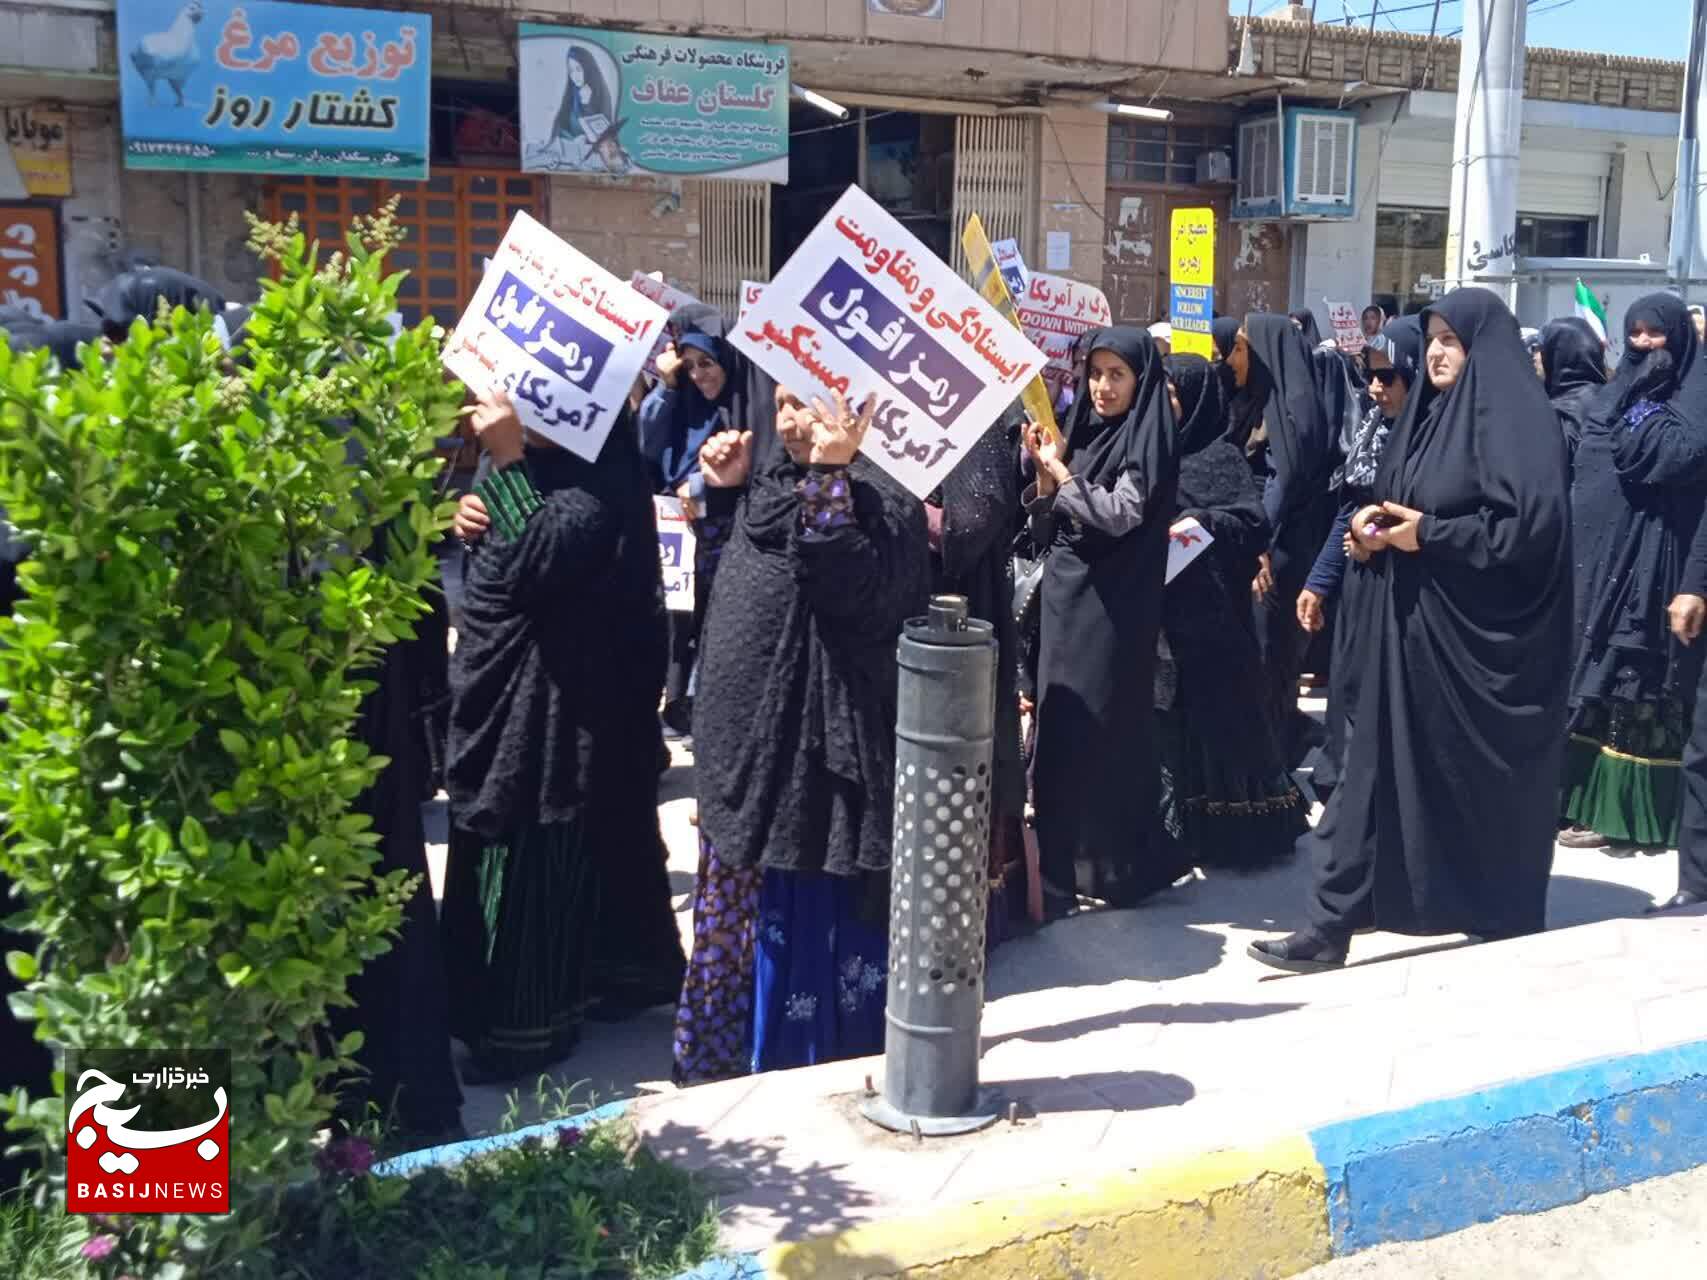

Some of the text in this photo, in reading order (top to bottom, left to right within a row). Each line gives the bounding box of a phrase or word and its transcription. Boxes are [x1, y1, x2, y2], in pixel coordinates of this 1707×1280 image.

[216, 8, 417, 80] توزیع مرغ
[622, 43, 785, 75] فروشگاه محصولات فرهنگی
[205, 86, 397, 132] کشتار روز
[631, 74, 776, 115] گلستان عفاف
[553, 277, 654, 342] ایستادگی
[834, 214, 1032, 384] ایستادگی و مقاومت
[1021, 311, 1062, 334] DOWN
[1029, 278, 1074, 312] آمریکا
[489, 284, 593, 383] رمز افول
[745, 319, 850, 395] مستکبر
[819, 288, 960, 417] رمز افول
[504, 370, 609, 432] آمریکای
[847, 396, 957, 468] آمریکا
